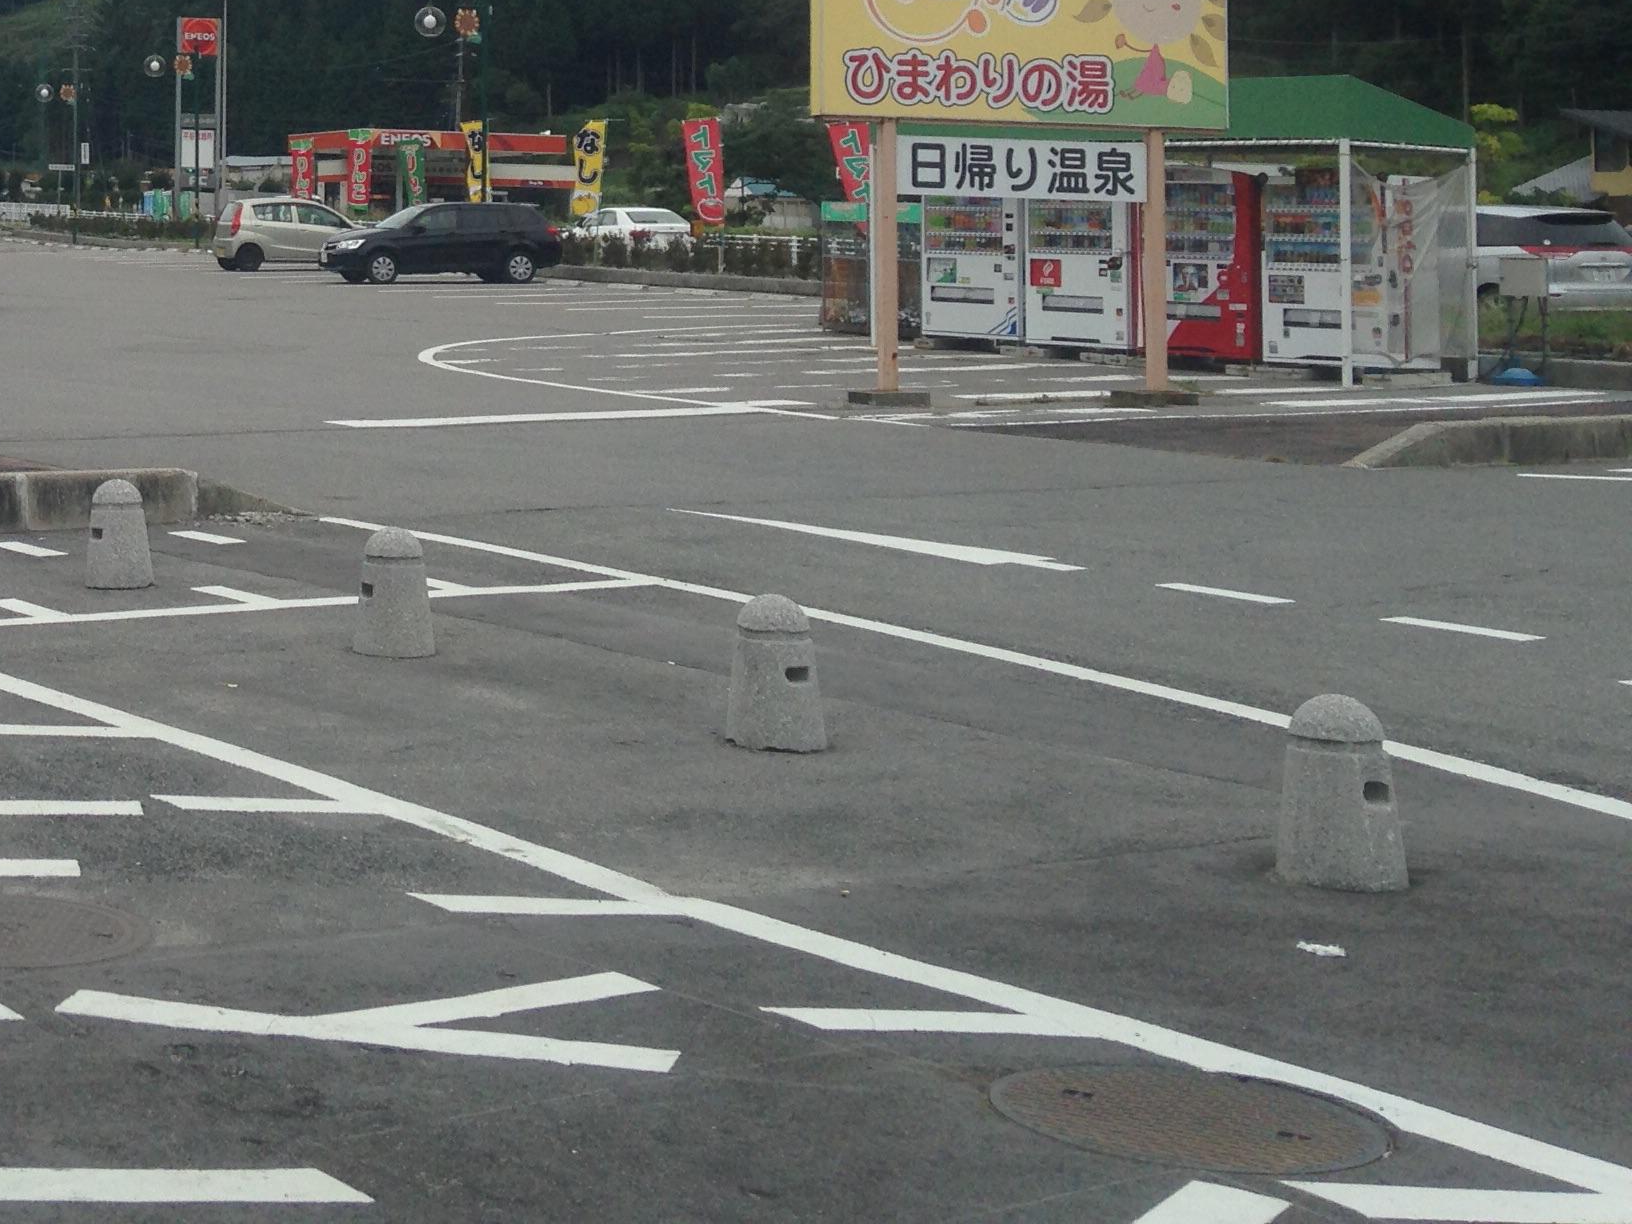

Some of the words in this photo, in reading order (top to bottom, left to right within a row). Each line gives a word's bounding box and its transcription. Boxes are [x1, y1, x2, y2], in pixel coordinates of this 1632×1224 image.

[183, 32, 216, 41] ENEOS
[845, 49, 1113, 113] ひまわりの湯
[576, 129, 601, 184] なし
[911, 141, 1136, 198] 日帰り温泉
